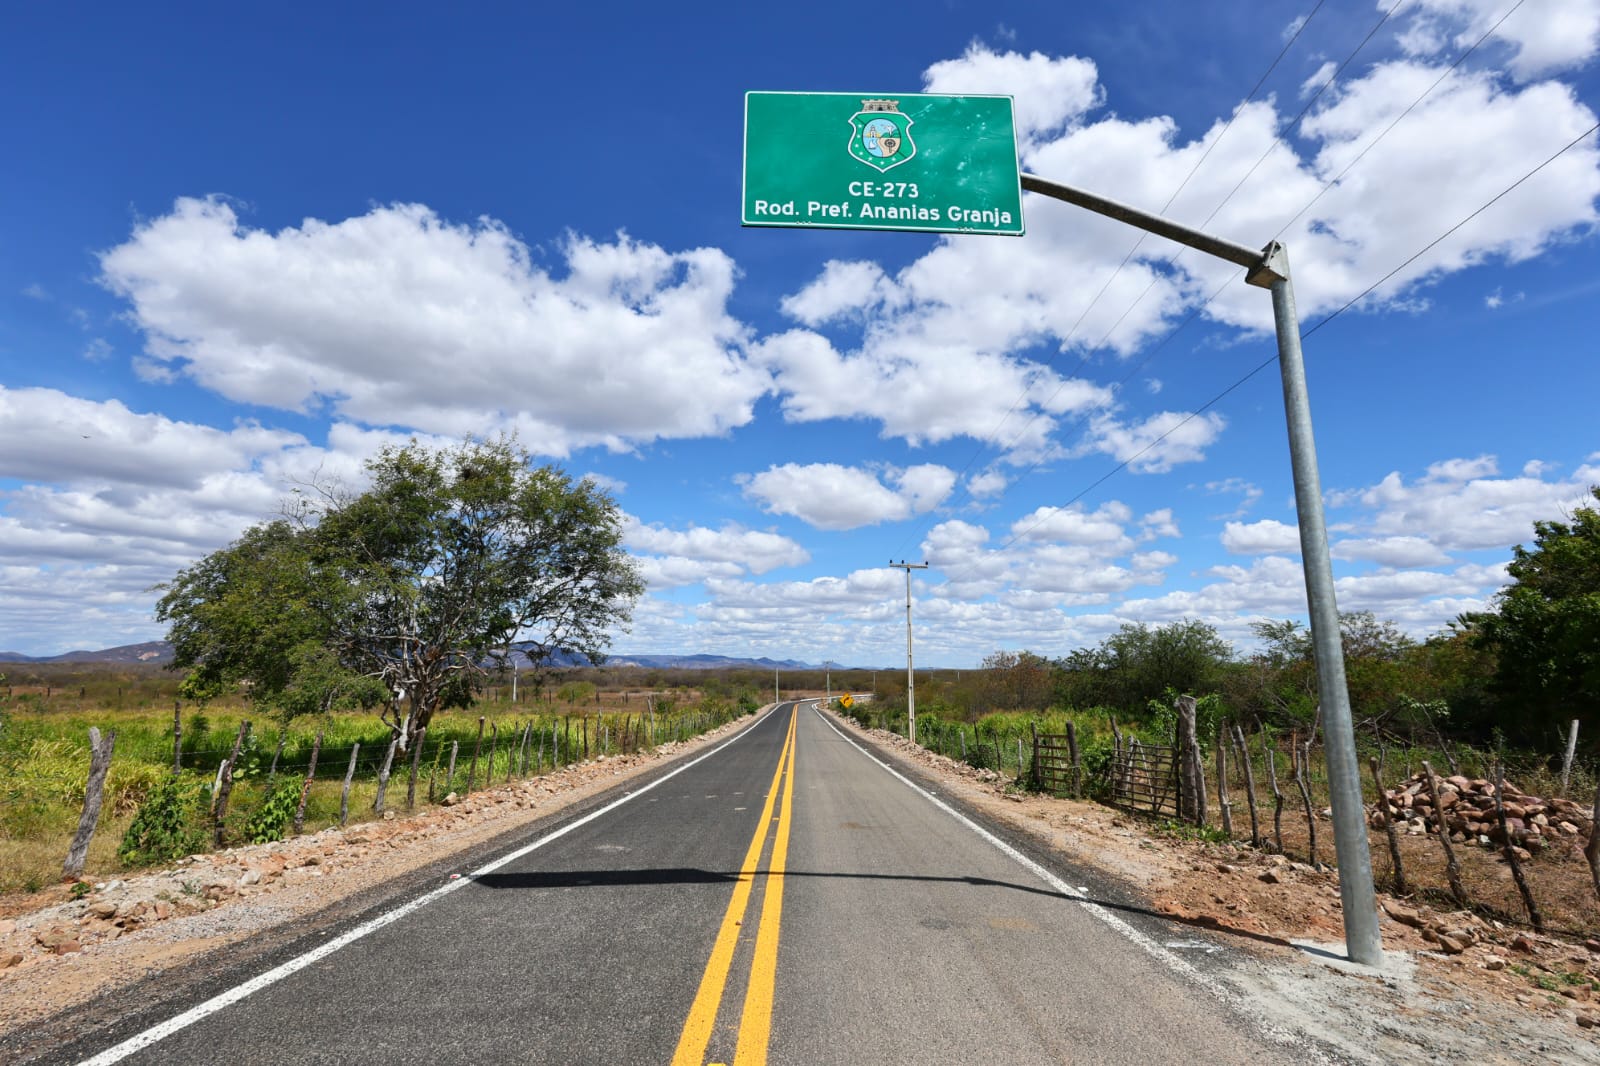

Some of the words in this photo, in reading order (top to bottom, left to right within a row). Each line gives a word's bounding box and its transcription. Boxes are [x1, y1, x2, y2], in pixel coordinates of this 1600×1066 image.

[849, 181, 919, 198] CE-273
[755, 200, 800, 216] Rod.
[807, 202, 852, 218] Pref.
[860, 203, 940, 220] Ananias
[947, 206, 1012, 227] Granja
